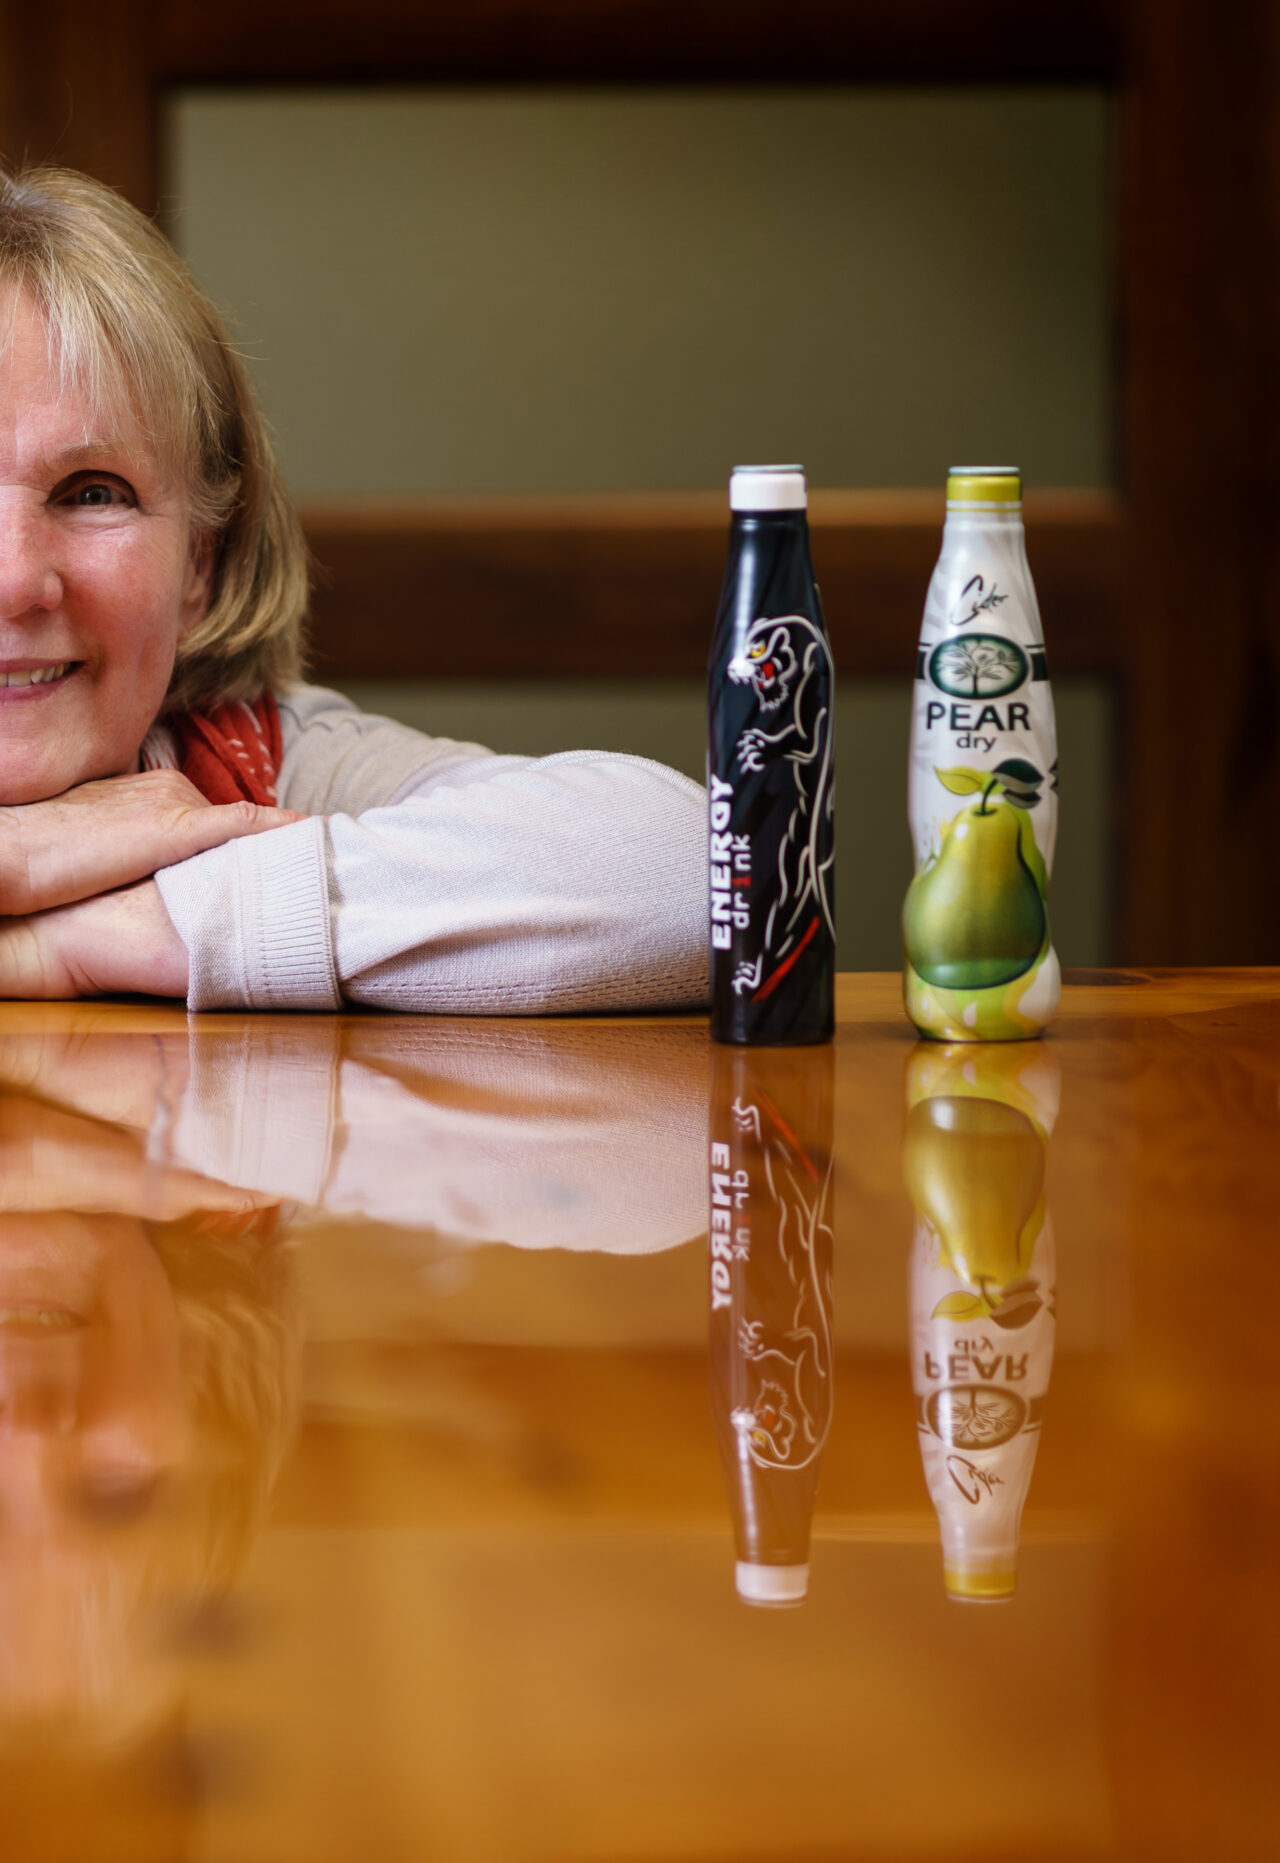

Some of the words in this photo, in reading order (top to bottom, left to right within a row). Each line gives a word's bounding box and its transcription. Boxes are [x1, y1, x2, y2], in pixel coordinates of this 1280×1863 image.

[926, 701, 1031, 731] PEAR
[956, 731, 997, 753] dry
[711, 774, 734, 949] ENERGY
[733, 834, 751, 930] drink
